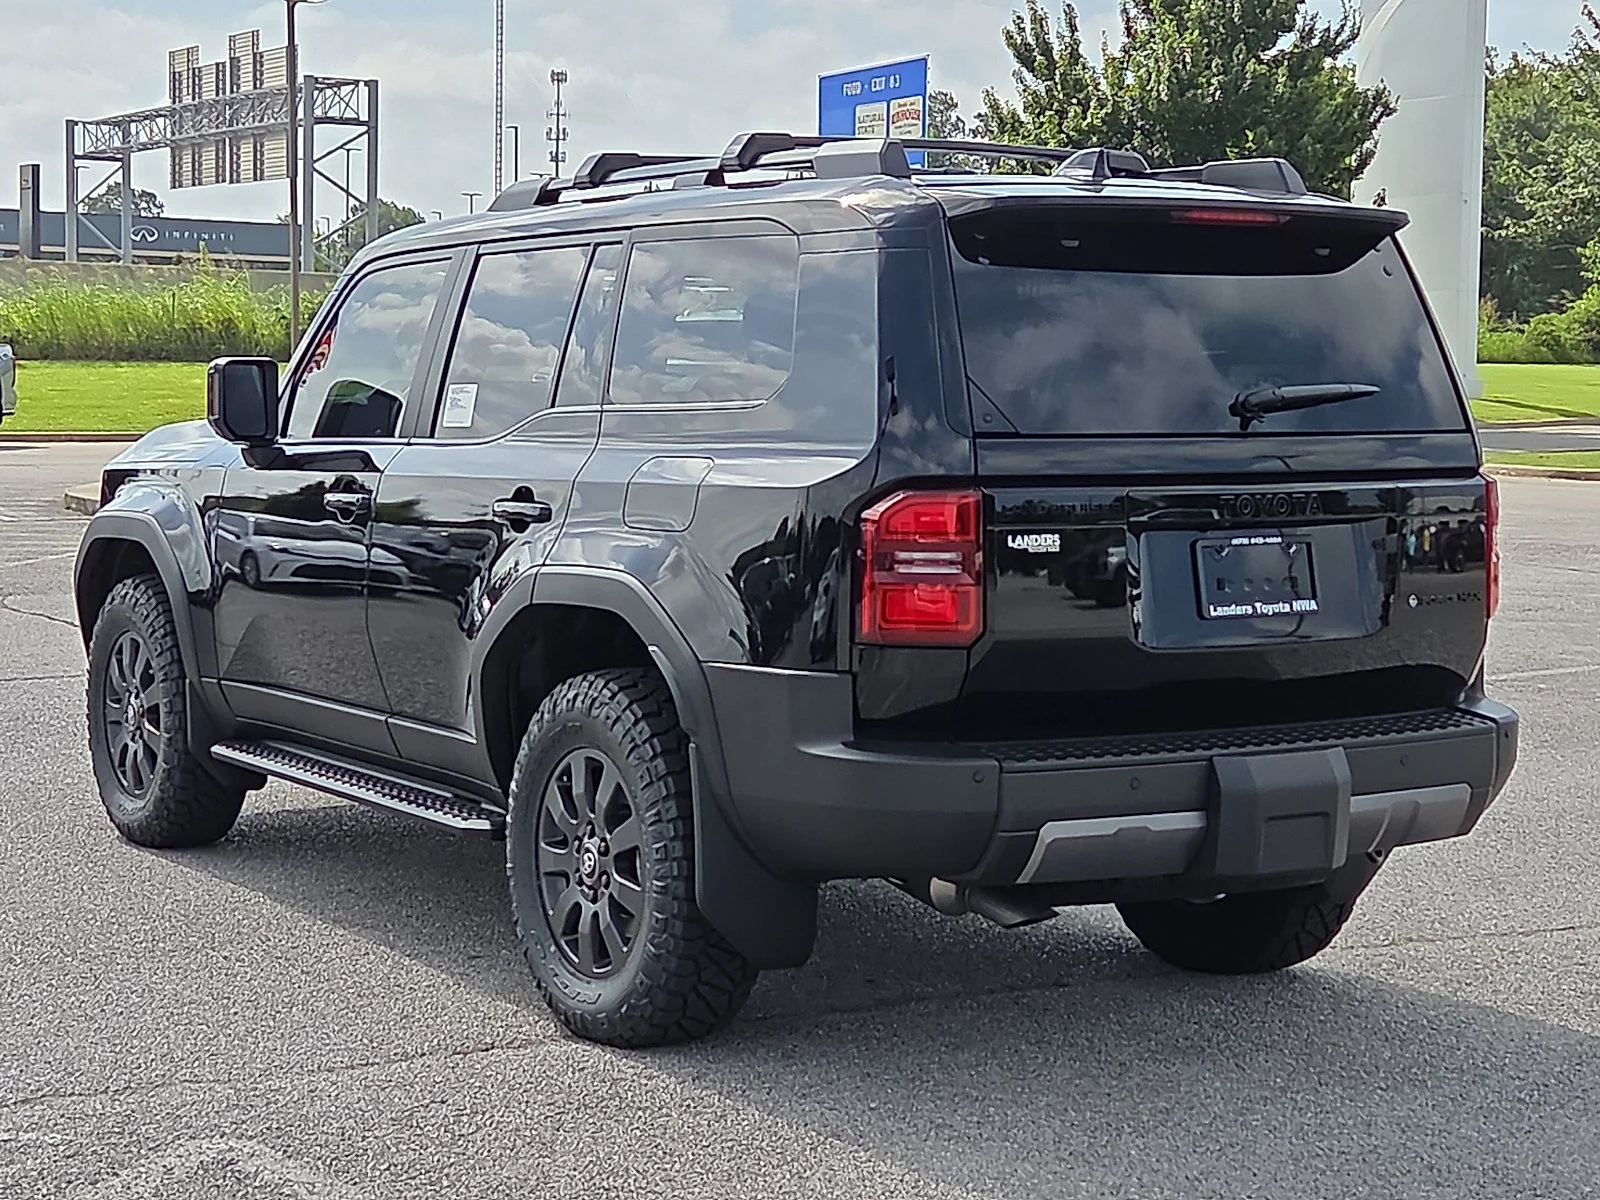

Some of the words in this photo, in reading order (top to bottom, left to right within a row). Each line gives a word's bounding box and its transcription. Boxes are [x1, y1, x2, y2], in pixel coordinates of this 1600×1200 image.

[165, 230, 234, 241] INFINITI
[1219, 493, 1323, 518] TOYOTA
[1007, 534, 1060, 548] LANDERS
[1209, 604, 1253, 616] Landers
[1254, 601, 1291, 615] Toyota
[1292, 599, 1318, 611] NWA
